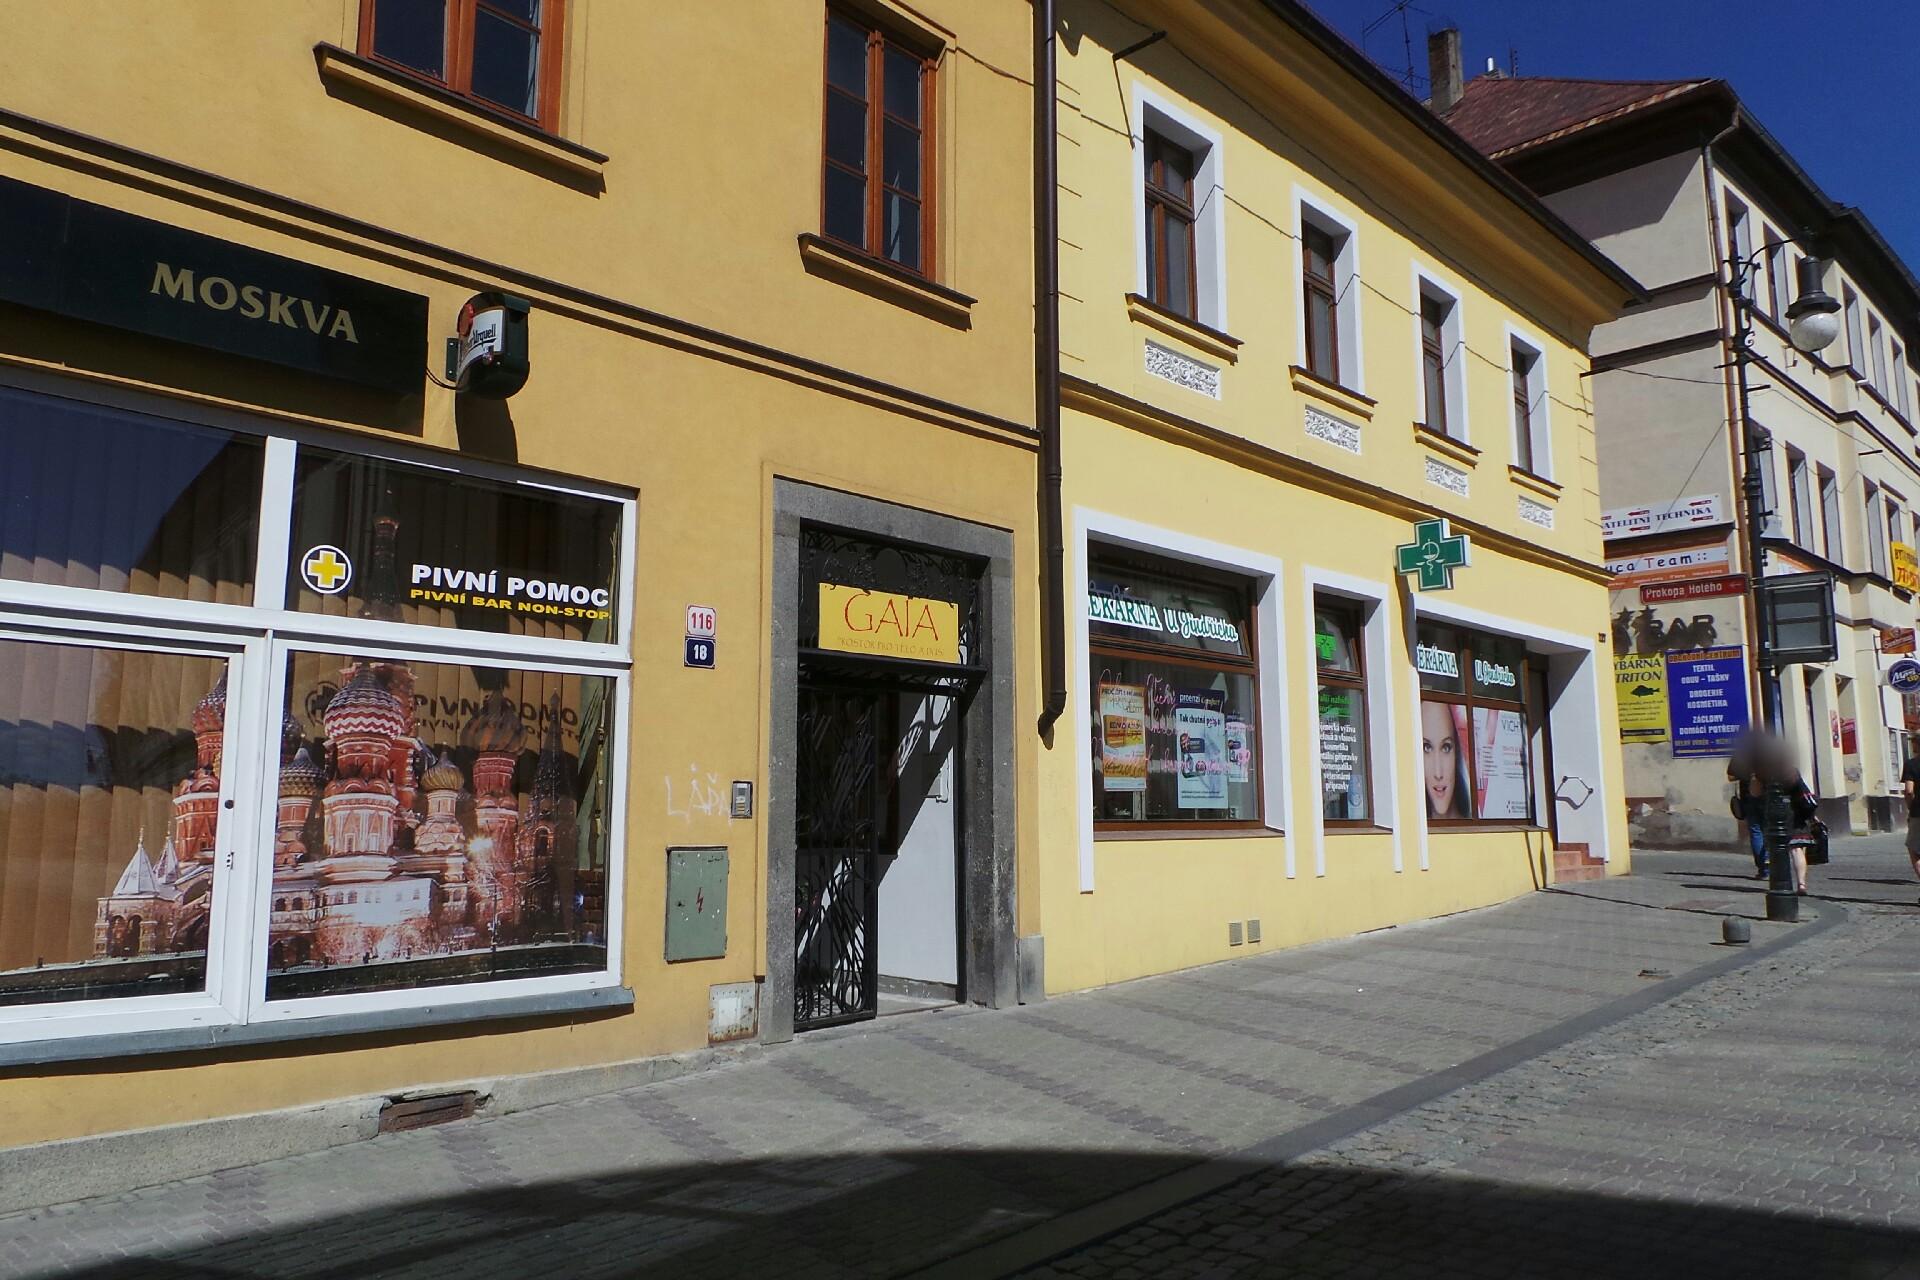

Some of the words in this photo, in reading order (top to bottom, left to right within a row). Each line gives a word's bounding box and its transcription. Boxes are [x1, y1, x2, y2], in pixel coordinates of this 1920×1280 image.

[151, 262, 359, 343] MOSKVA
[1656, 506, 1712, 521] TECHNIKA
[1644, 554, 1693, 568] Team
[411, 564, 498, 593] PIVNÍ
[507, 577, 609, 606] POMOC
[1646, 587, 1685, 600] Prokopa
[410, 589, 466, 604] PIVNÍ
[472, 596, 512, 610] BAR
[518, 602, 610, 620] NON-STOP
[691, 612, 713, 631] 116
[844, 593, 939, 641] GAIA
[693, 645, 708, 660] 18
[1615, 671, 1663, 684] TRITON
[1689, 689, 1724, 698] DROGERIE
[1687, 699, 1728, 709] KOSMETIKA
